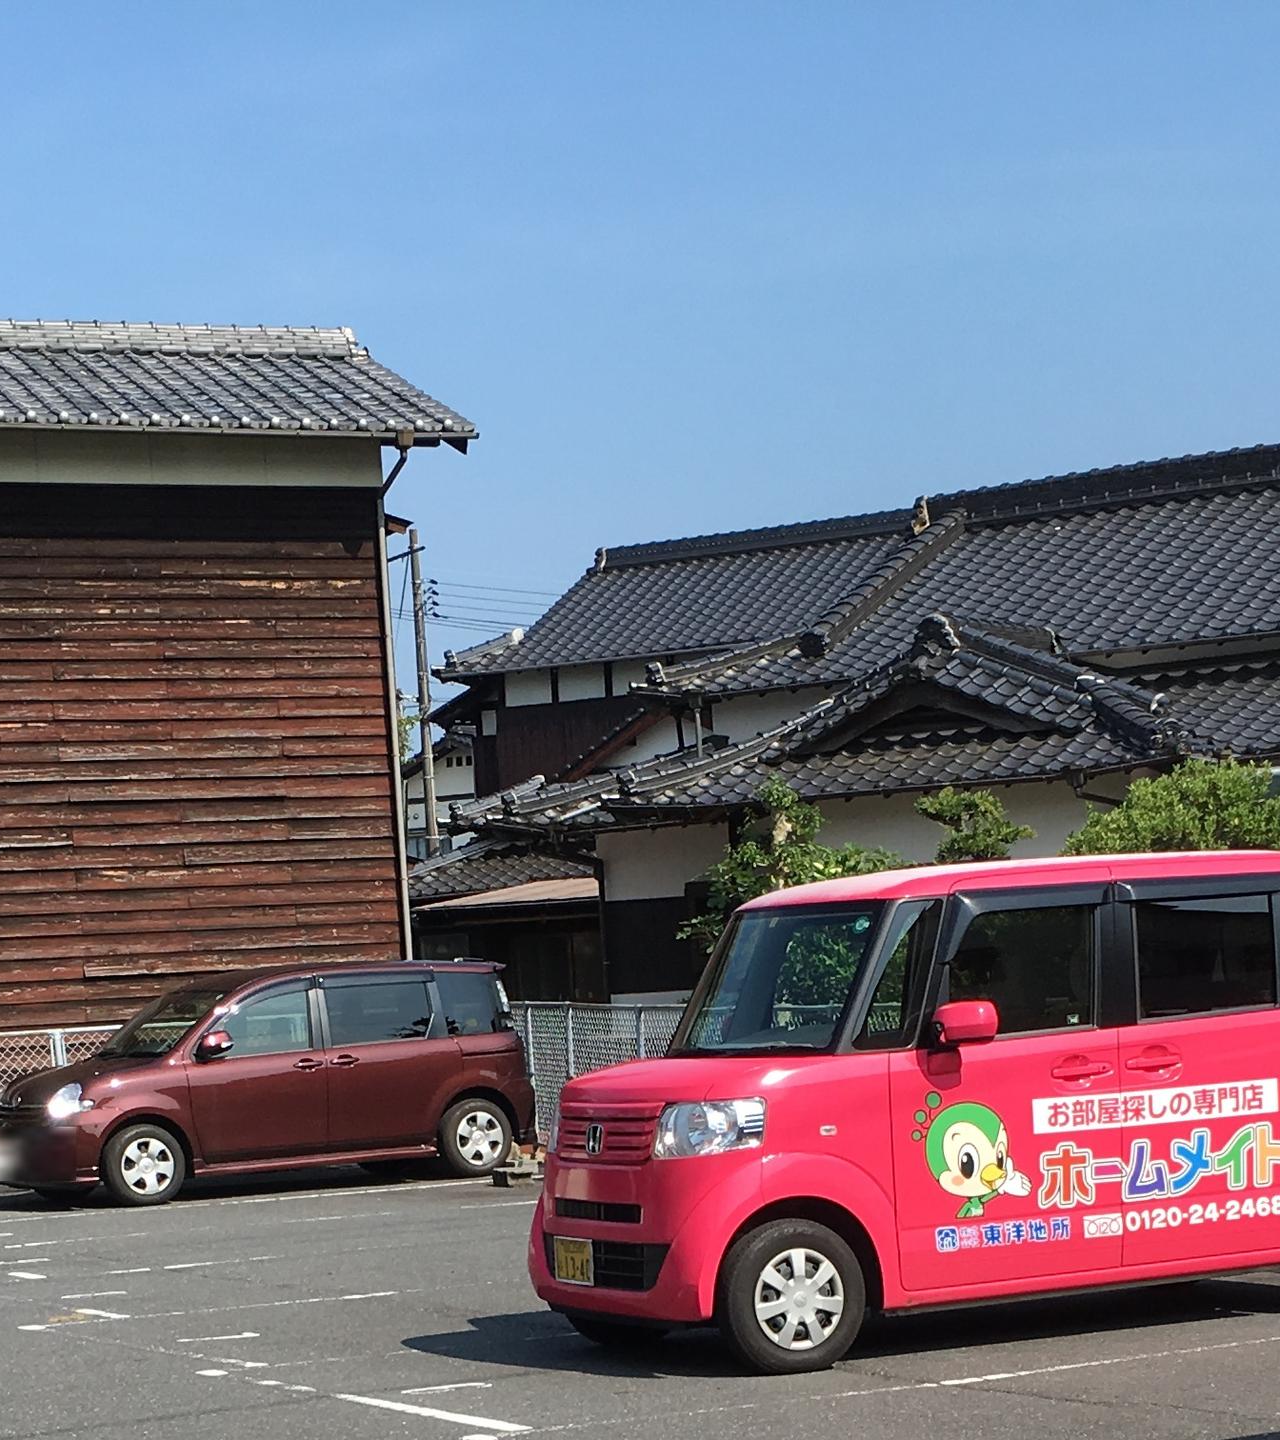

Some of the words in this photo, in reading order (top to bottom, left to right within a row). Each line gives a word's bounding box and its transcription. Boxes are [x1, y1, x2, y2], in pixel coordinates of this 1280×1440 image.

[1047, 1084, 1264, 1128] お部屋探しの専門店
[981, 1218, 1072, 1247] 東洋地所
